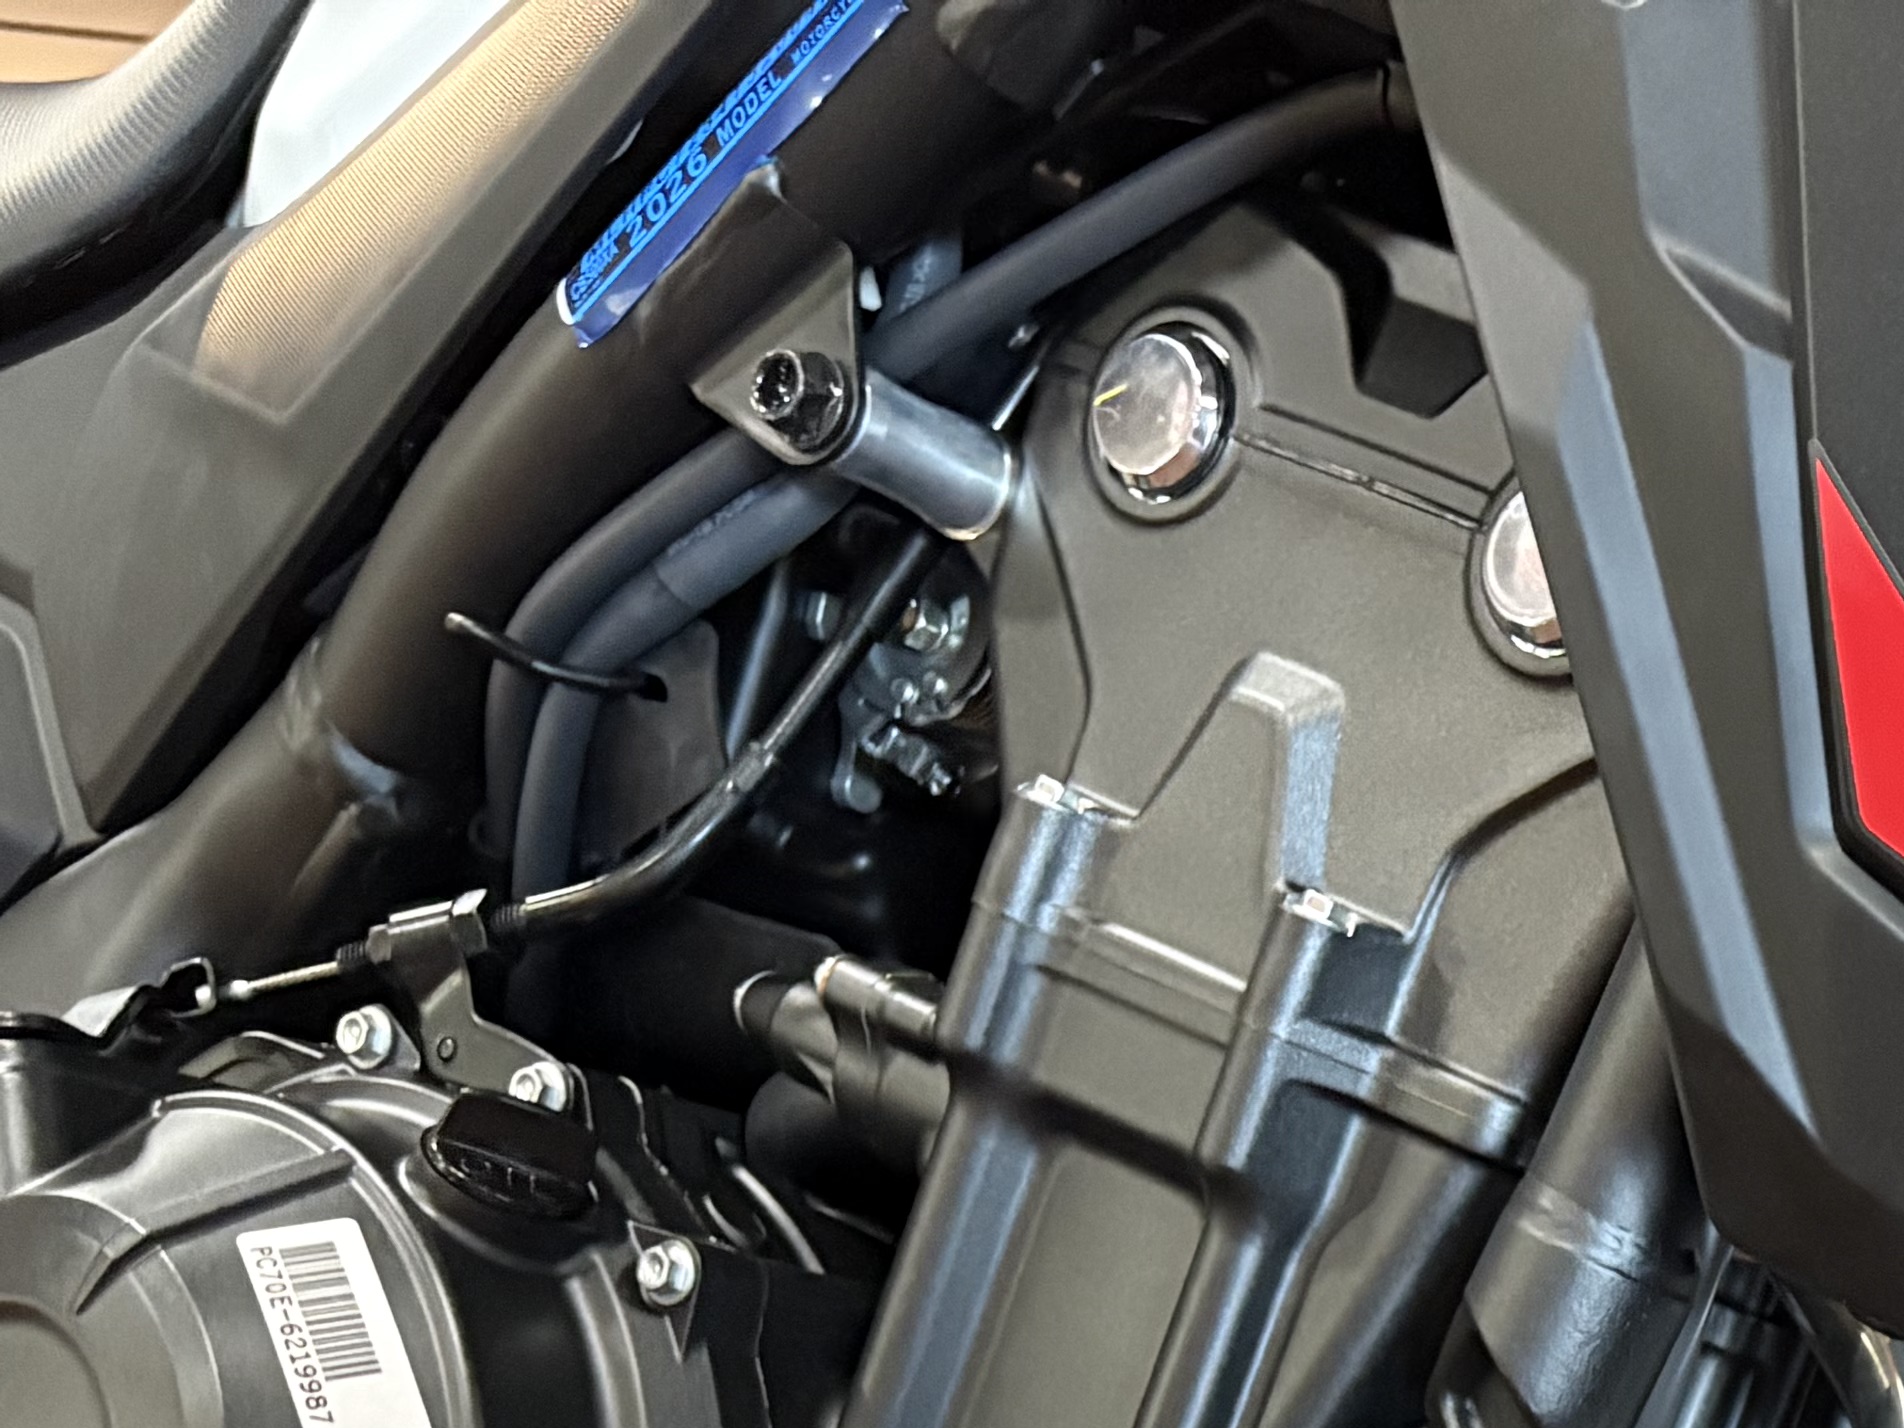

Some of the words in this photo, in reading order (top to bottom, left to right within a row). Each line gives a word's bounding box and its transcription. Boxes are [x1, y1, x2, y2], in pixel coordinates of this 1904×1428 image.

[627, 146, 707, 248] 2026
[715, 70, 782, 147] MODEL
[249, 1246, 335, 1427] PC70E-6219987
